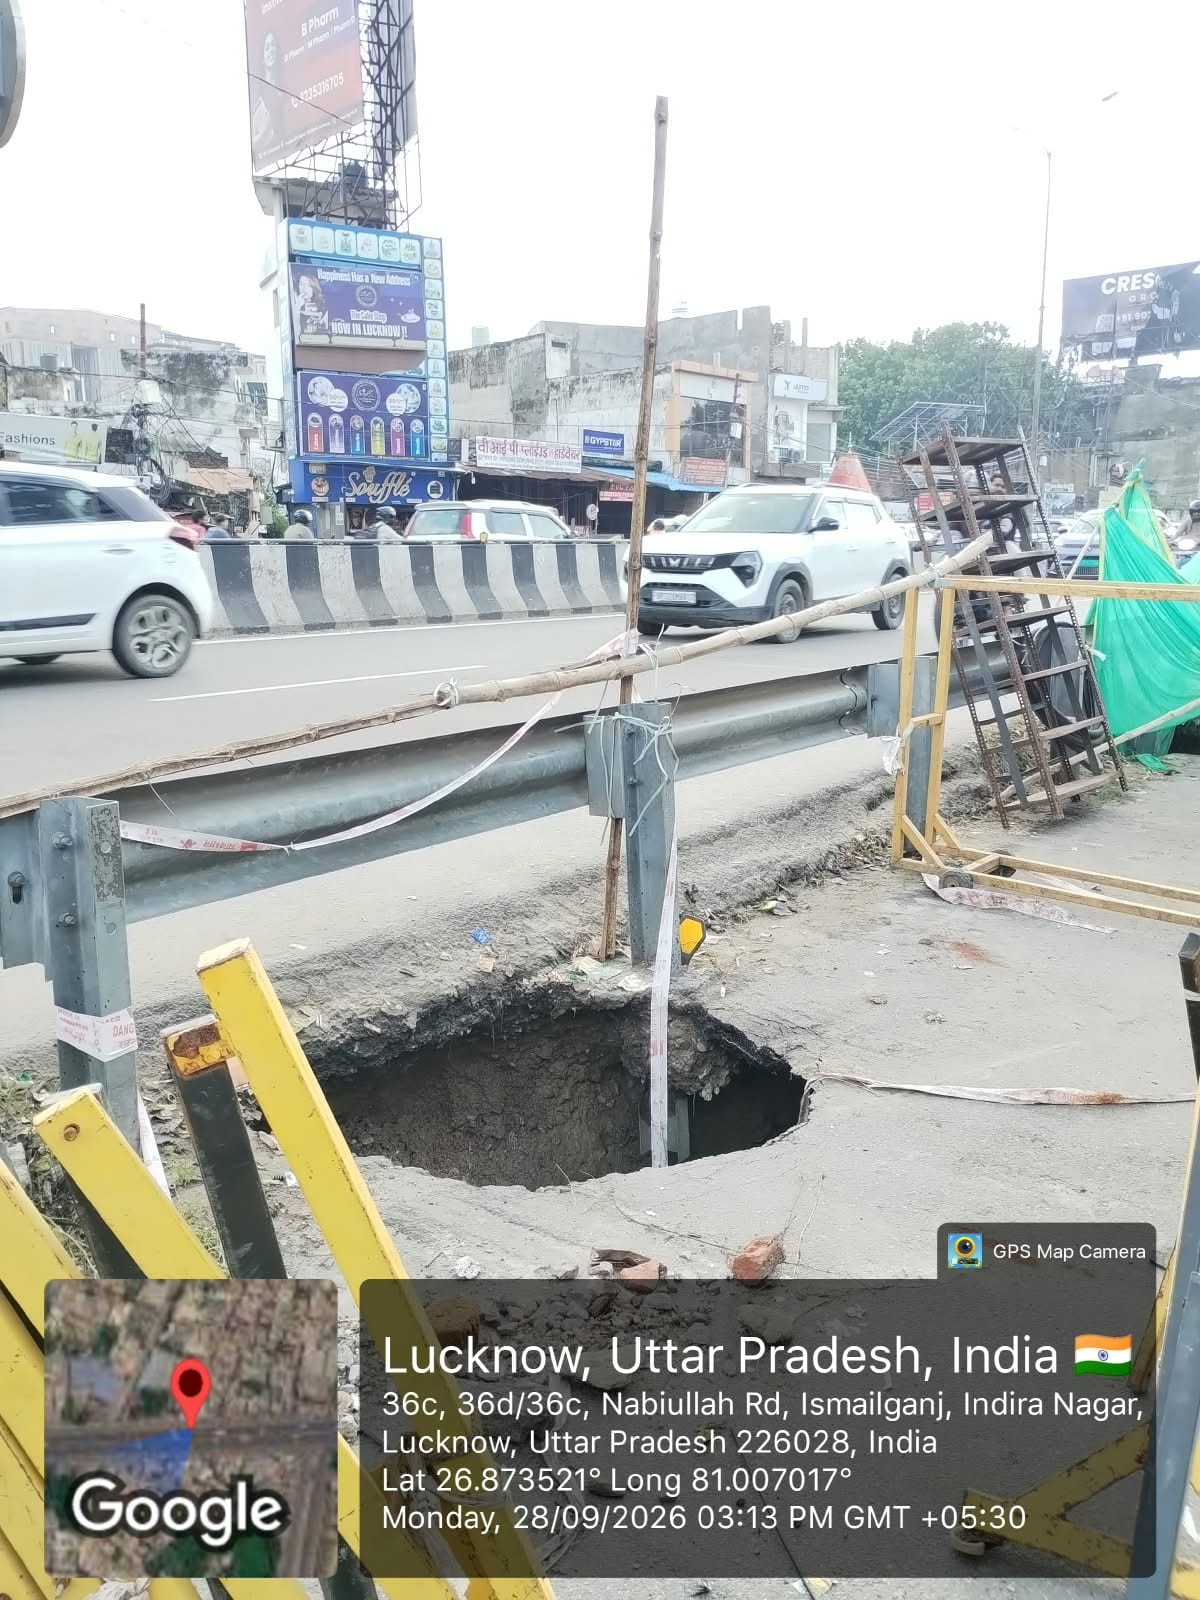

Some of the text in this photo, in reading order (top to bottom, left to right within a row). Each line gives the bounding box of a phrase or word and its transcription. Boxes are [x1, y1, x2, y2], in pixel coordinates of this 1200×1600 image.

[301, 7, 339, 37] B Pharm
[331, 322, 351, 335] NOW
[351, 322, 362, 336] IN
[362, 323, 402, 337] LUCKNOW
[590, 436, 623, 448] GYPSTAR
[341, 471, 413, 504] Soufflé
